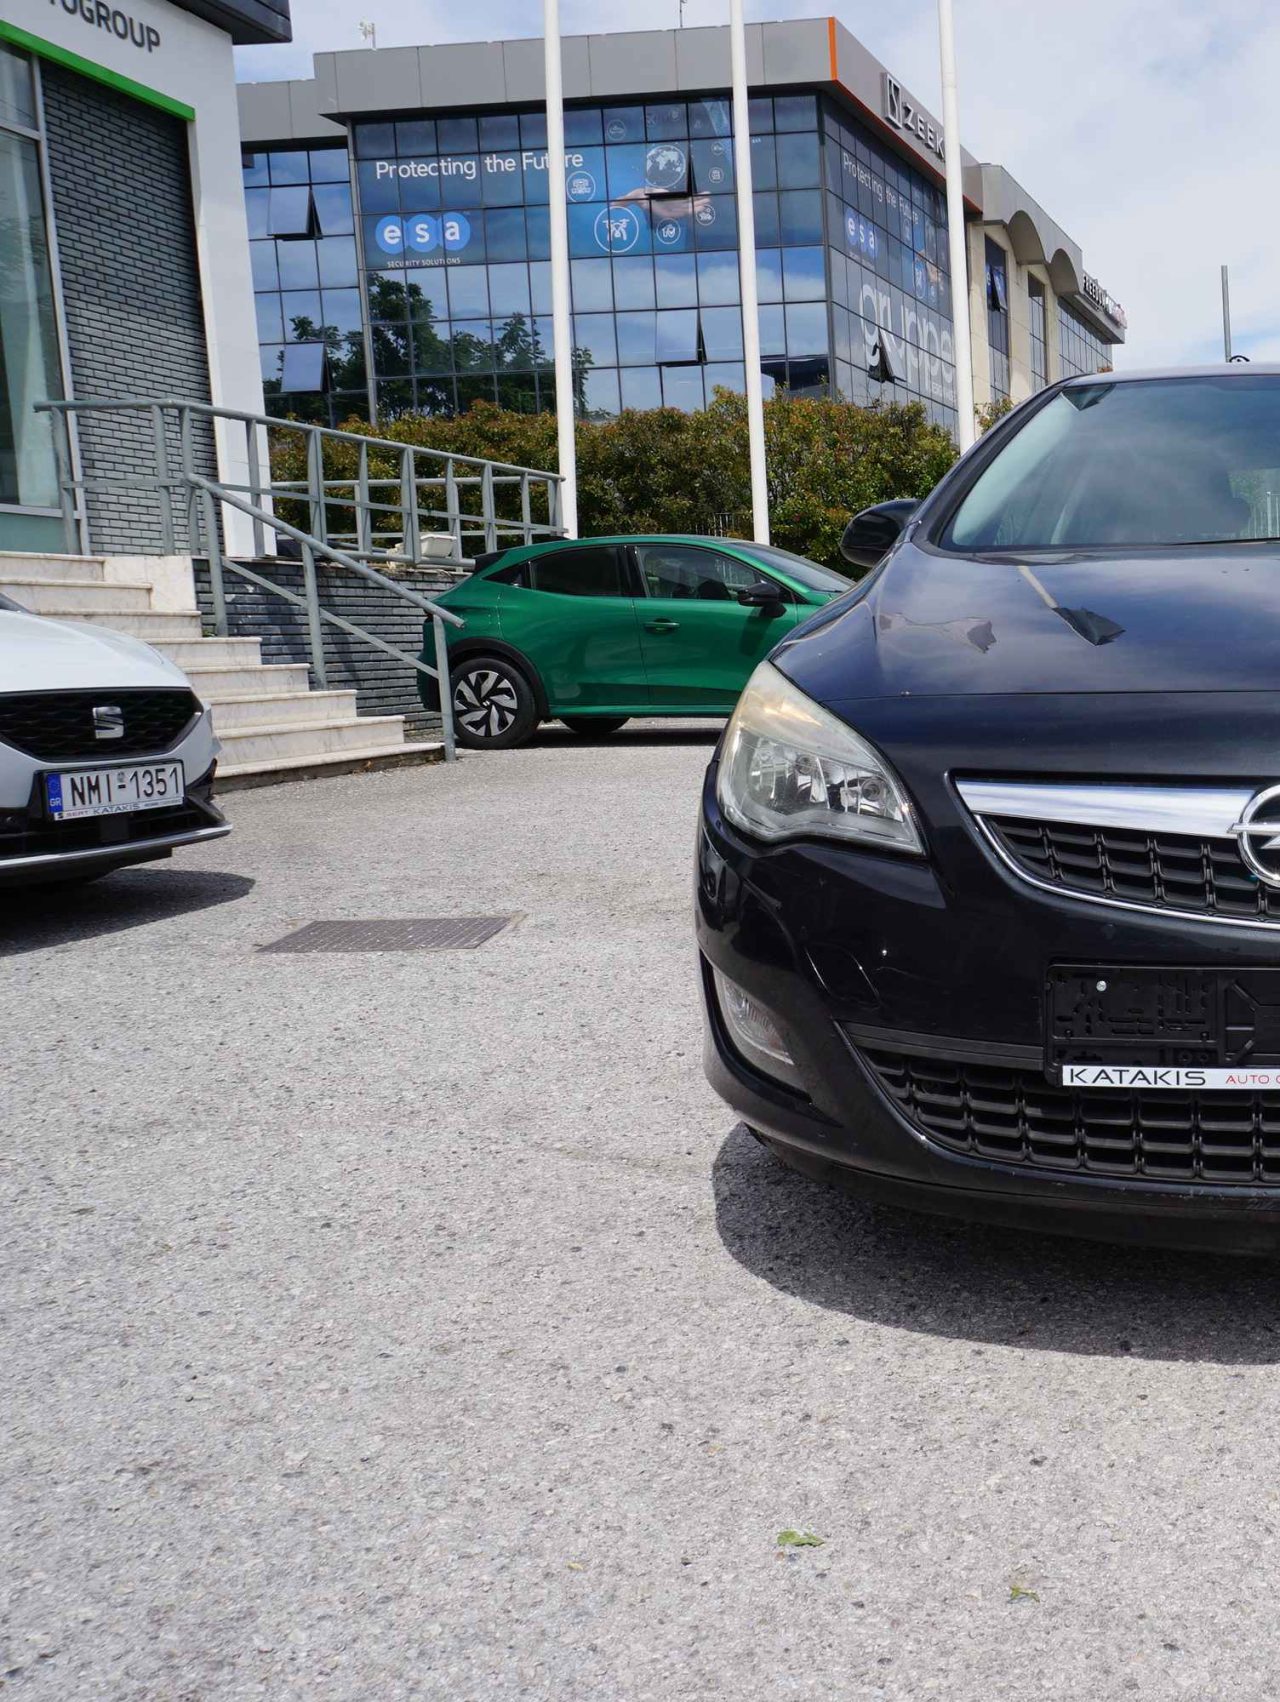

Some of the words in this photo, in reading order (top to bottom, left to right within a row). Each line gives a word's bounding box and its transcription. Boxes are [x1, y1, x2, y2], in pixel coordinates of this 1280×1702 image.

[48, 0, 161, 53] OGROUP
[902, 103, 945, 159] ZEEK
[375, 158, 477, 180] Protecting
[484, 154, 517, 173] the
[522, 152, 584, 171] Futre
[843, 152, 883, 203] Protecting
[383, 221, 460, 245] esa
[848, 217, 875, 249] esa
[387, 260, 421, 269] SECURITY
[421, 257, 461, 267] SOLUTIONS
[49, 797, 62, 807] GR
[93, 804, 141, 816] KATAKIS
[1069, 1068, 1206, 1086] KATAKIS
[1225, 1074, 1270, 1085] AUTO
